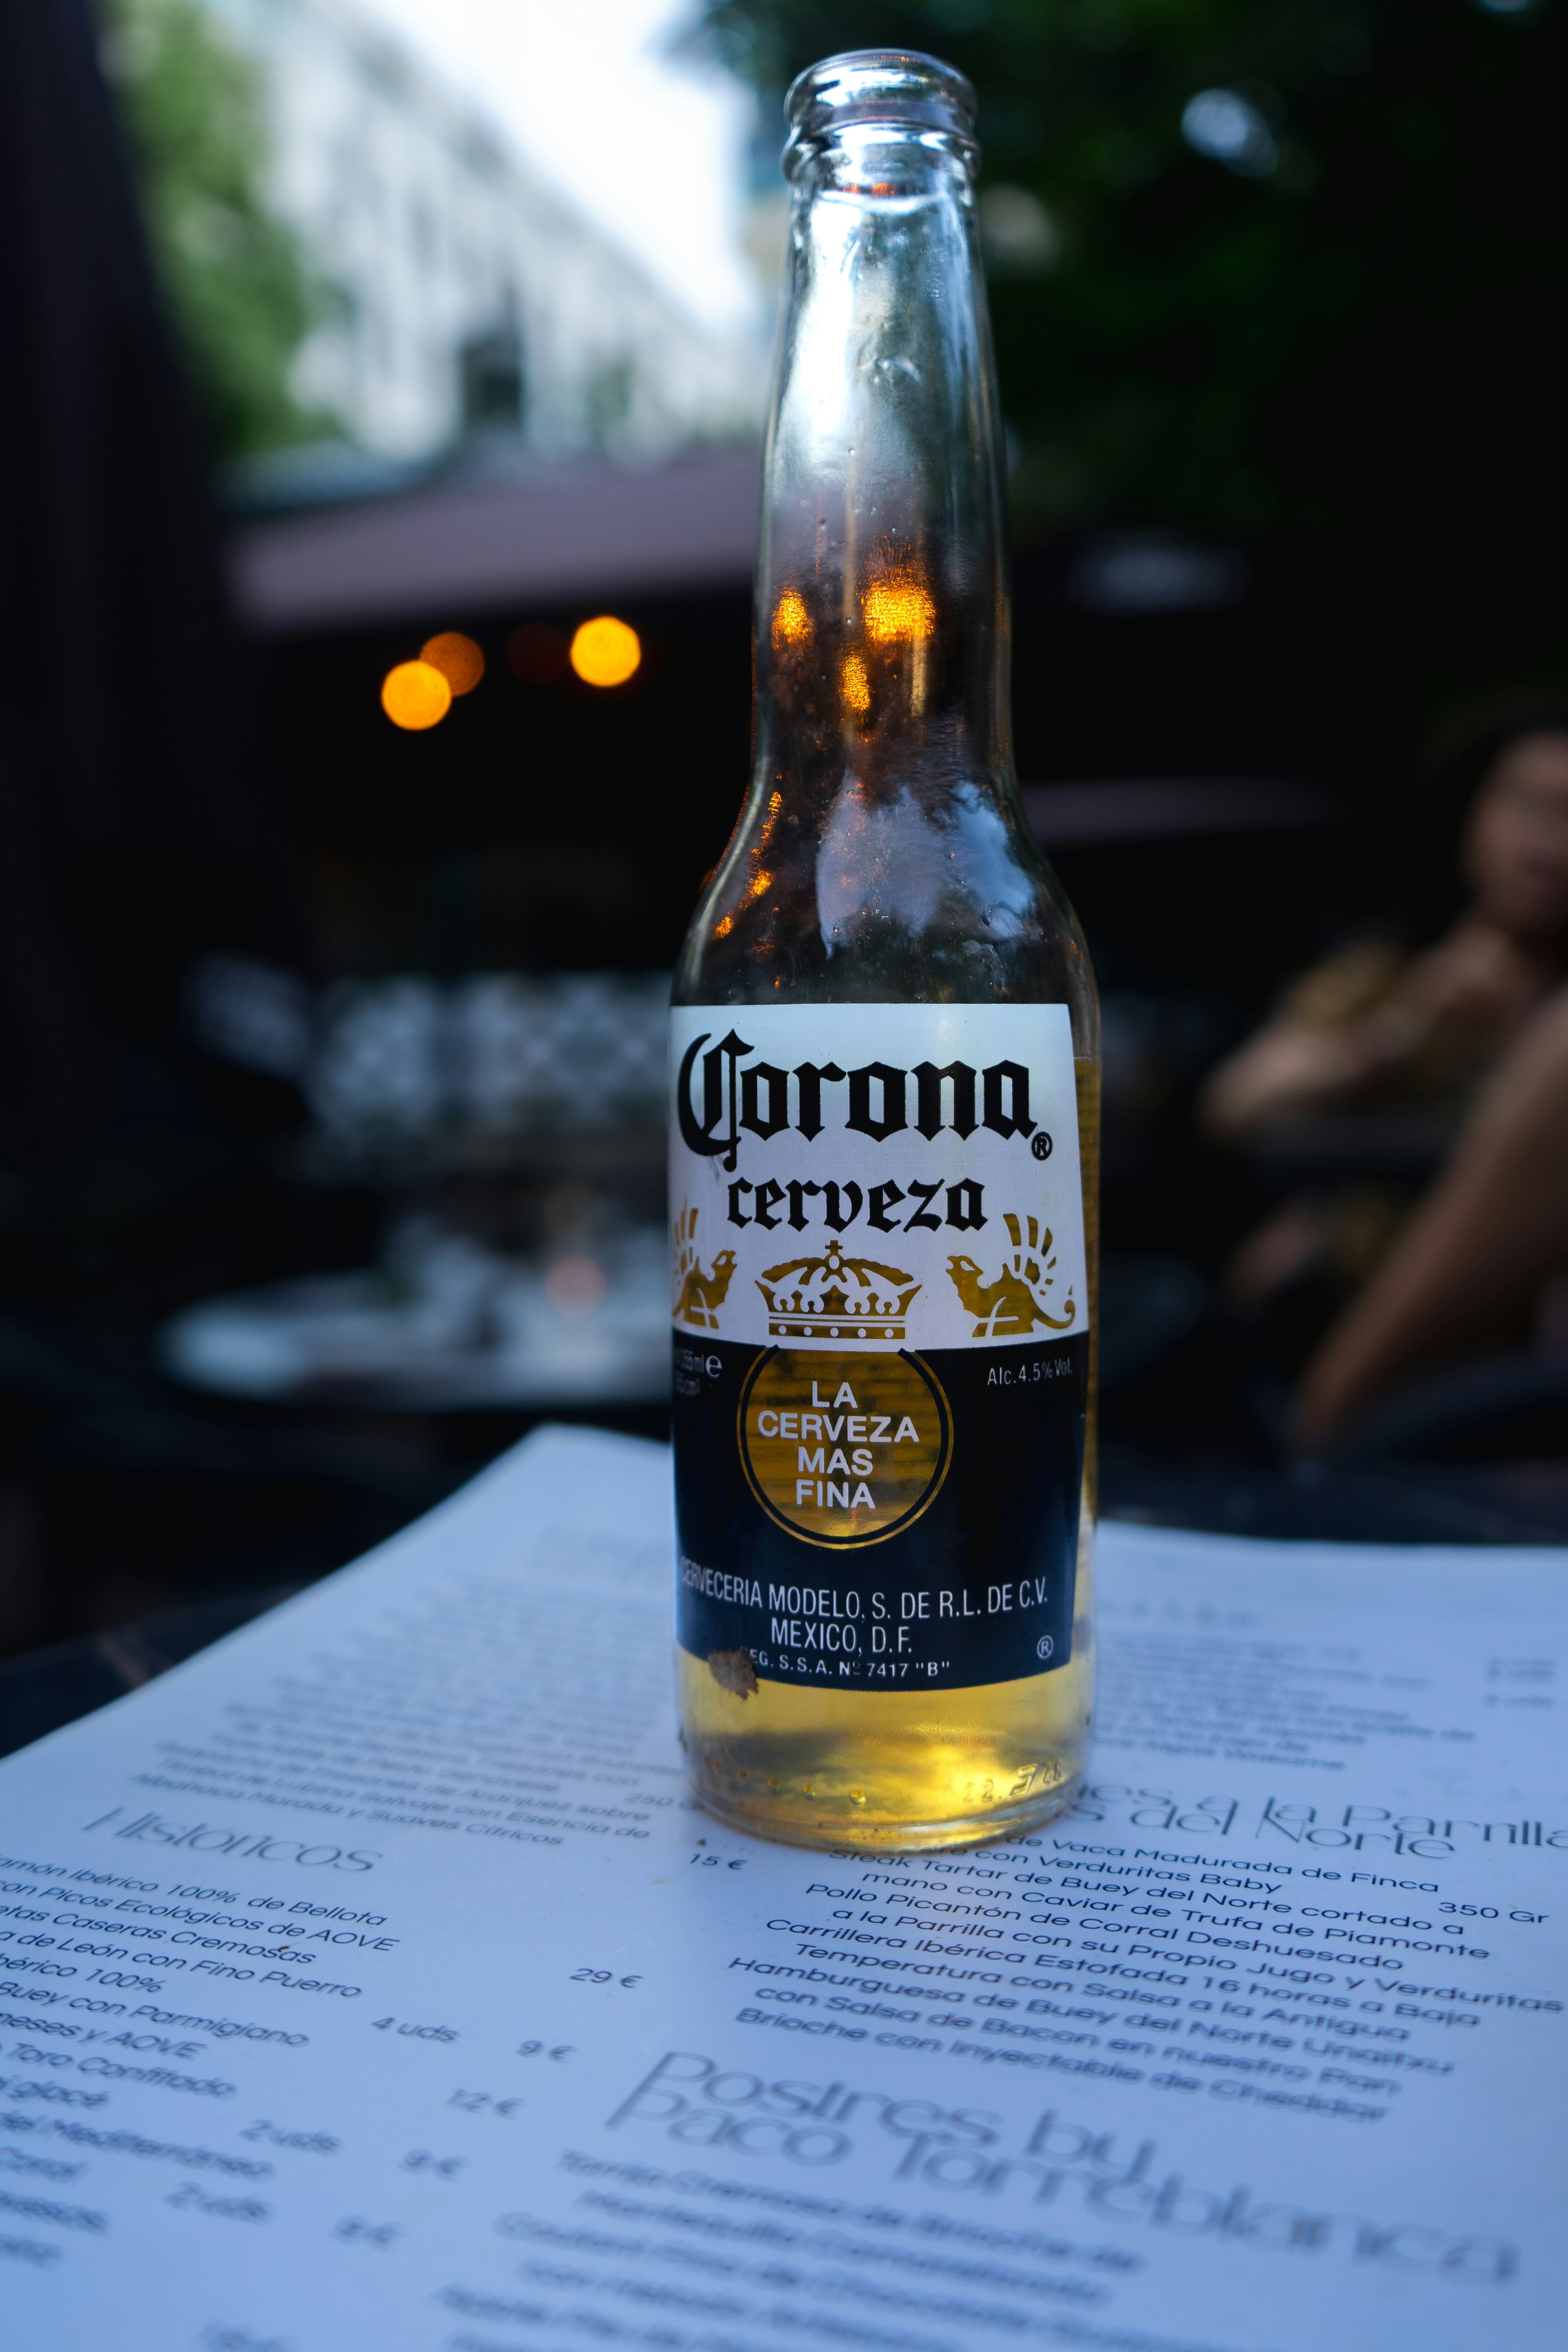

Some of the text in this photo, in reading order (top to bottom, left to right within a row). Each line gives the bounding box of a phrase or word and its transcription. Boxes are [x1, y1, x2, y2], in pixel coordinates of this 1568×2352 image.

[677, 1029, 1038, 1172] Corona
[727, 1176, 988, 1234] cerveza
[812, 1381, 858, 1408] LA
[757, 1410, 920, 1443] CERVEZA
[798, 1446, 873, 1476] MAS
[796, 1479, 875, 1509] FINA
[902, 1592, 930, 1619] DE
[988, 1584, 1013, 1613] DE
[771, 1617, 862, 1657] MEXICO,
[749, 1649, 774, 1667] EG.
[867, 1663, 909, 1677] 7417
[365, 1809, 460, 1830] Suaves
[506, 1811, 610, 1834] Esencia
[614, 1826, 650, 1839] de
[689, 1853, 748, 1870] 15 €
[975, 1850, 1028, 1864] con
[1039, 1855, 1191, 1882] Verduritas
[1200, 1873, 1282, 1894] Baby
[1052, 1839, 1125, 1857] Vaca
[1134, 1848, 1292, 1875] Madurada
[1301, 1867, 1341, 1880] de
[1350, 1872, 1439, 1892] Finca
[0, 1857, 388, 1926] amón Ibérico 100% de Bellota
[829, 1847, 1464, 1935] Steak Tartar de Buey del Norte cortado a
[1438, 1901, 1550, 1924] 350 Gr
[38, 1886, 401, 1951] Picos Ecológicos de AOVE
[805, 1883, 1404, 1971] Pollo Picantón de Corral Deshuesado
[862, 1873, 1490, 1959] mano con Caviar de Trufa de Piamonte
[53, 1913, 167, 1940] Caseras
[171, 1931, 317, 1964] Cremosas
[0, 1953, 167, 1993] bérico 100%
[17, 1933, 55, 1947] de
[56, 1937, 129, 1960] León
[131, 1953, 188, 1970] con
[189, 1959, 256, 1980] Fino
[259, 1970, 363, 1998] Puerro
[569, 1967, 644, 1989] 29 €
[766, 1919, 1482, 2030] Carrillera Ibérica Estofada 16 horas a Baja
[832, 1909, 1566, 2015] a la Parrilla con su Propio Jugo y Verduritas
[728, 1957, 968, 2004] Hamburguesa
[972, 1993, 1021, 2011] de
[1024, 1998, 1120, 2028] Buey
[1122, 2013, 1183, 2034] del
[1187, 2018, 1296, 2053] Norte
[795, 1943, 1412, 2043] Temperatura con Salsa a la Antigua
[69, 1997, 127, 2015] con
[127, 2004, 310, 2047] Parmigiano
[369, 2017, 462, 2044] 4 uds
[734, 2007, 870, 2042] Brioche
[872, 2031, 945, 2053] con
[753, 1987, 820, 2007] con
[822, 1995, 922, 2023] Salsa
[926, 2011, 976, 2031] de
[980, 2018, 1102, 2049] Bacon
[1105, 2038, 1157, 2058] en
[5, 2042, 75, 2070] Toro
[77, 2029, 209, 2061] y AOVE
[515, 2040, 578, 2063] 9 €
